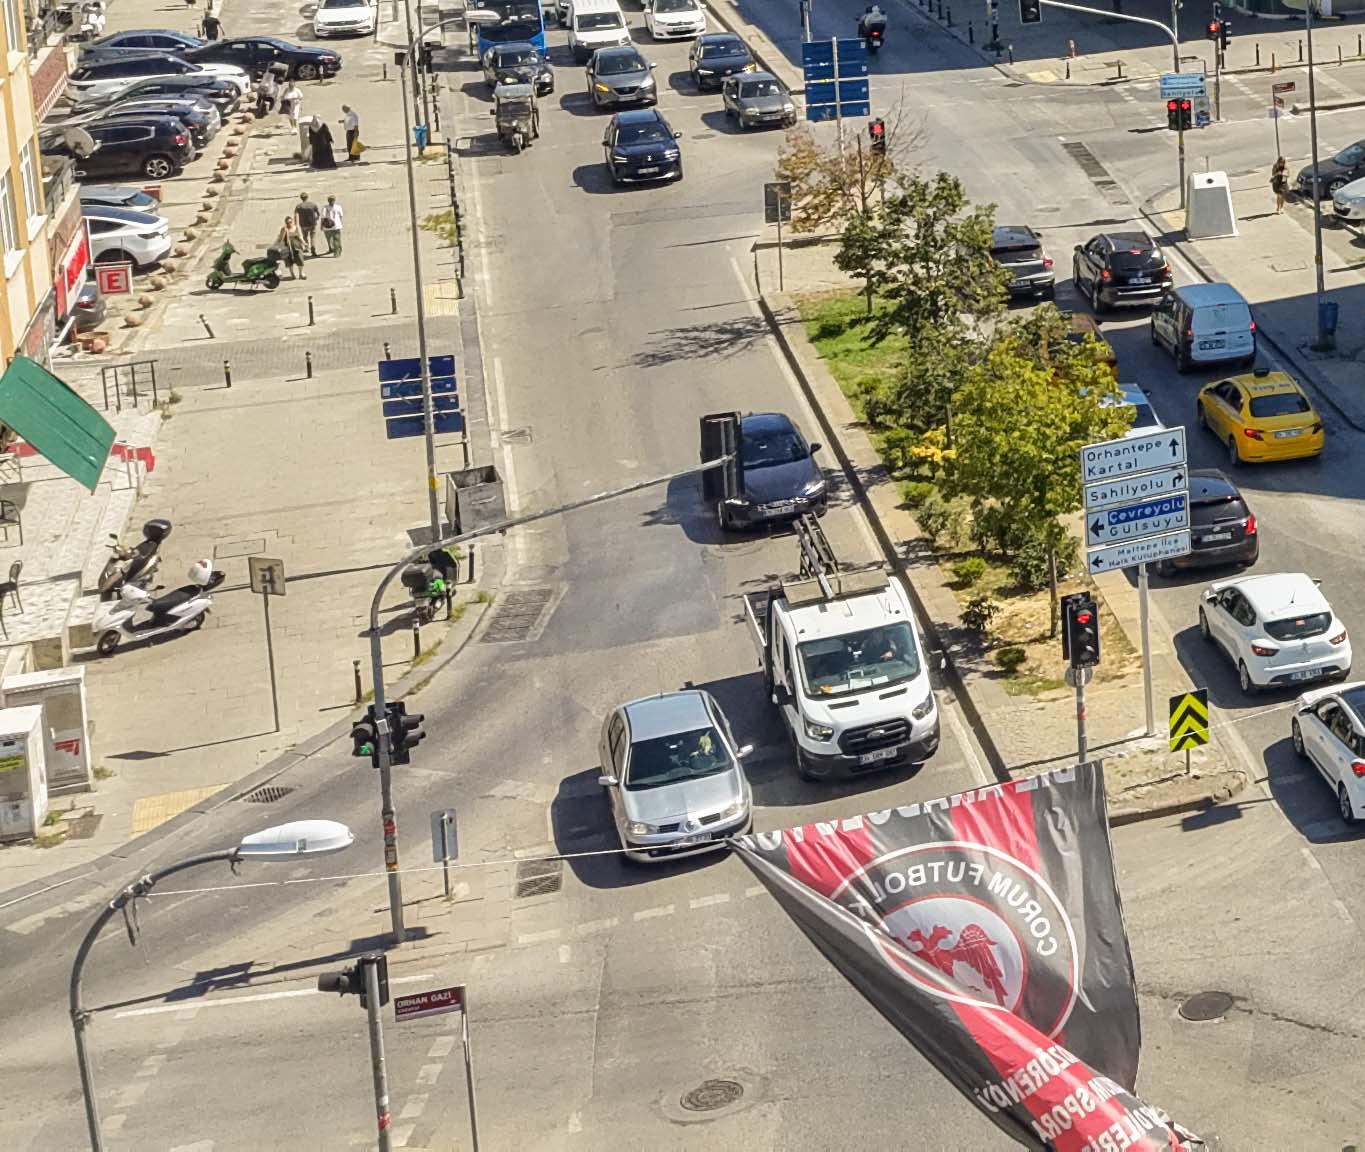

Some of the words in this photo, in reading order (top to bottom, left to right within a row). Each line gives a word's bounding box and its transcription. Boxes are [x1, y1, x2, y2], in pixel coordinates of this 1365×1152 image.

[107, 272, 121, 290] E
[1087, 440, 1162, 462] Orhantepe
[1088, 457, 1138, 477] Kartal
[1090, 480, 1164, 502] Sahilyolu
[1108, 499, 1185, 524] Çevreyolu
[397, 996, 428, 1008] ORHAN
[431, 990, 451, 1002] GAZİ
